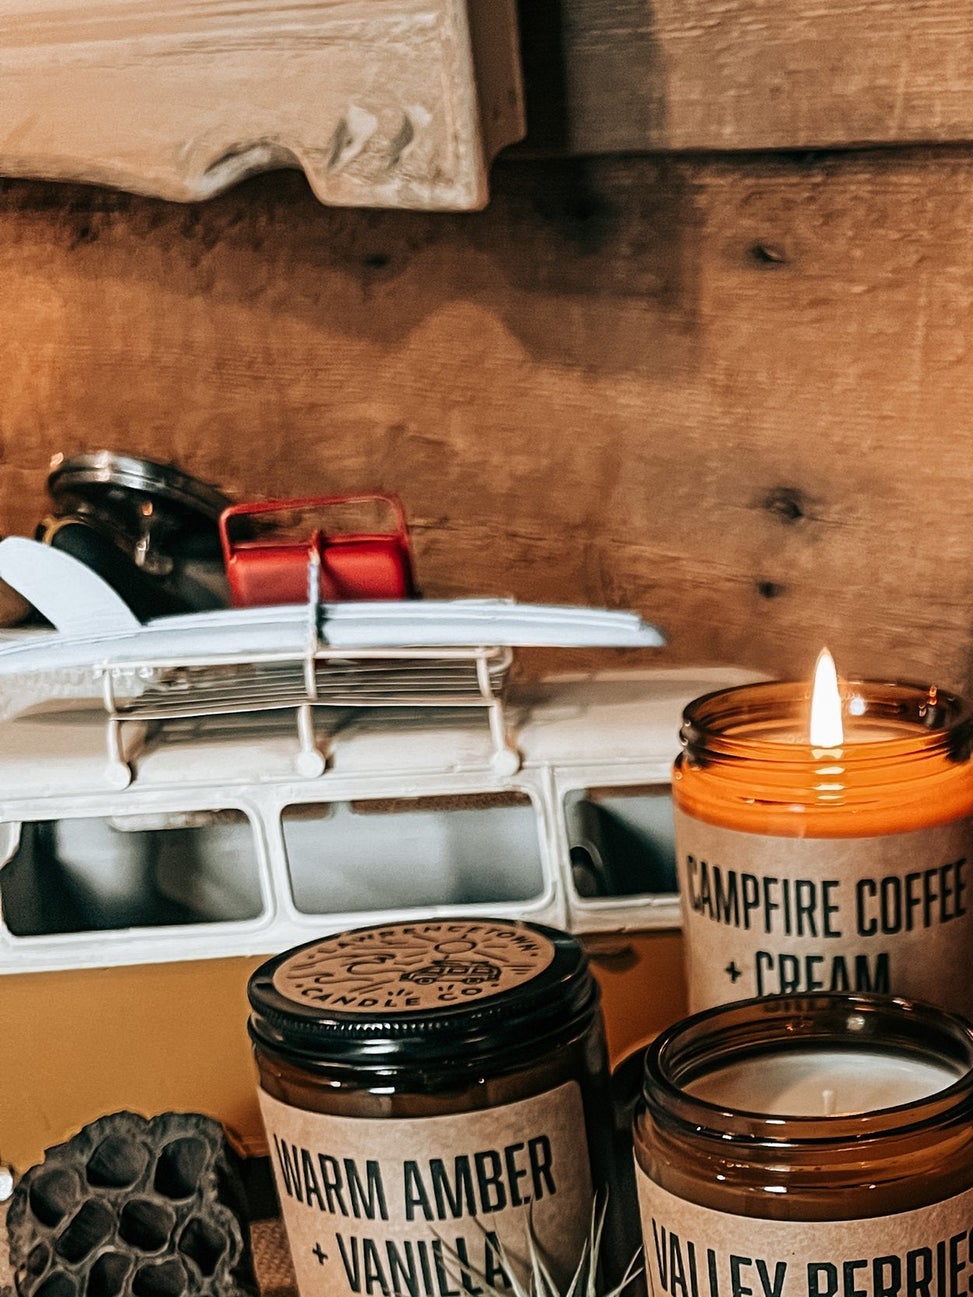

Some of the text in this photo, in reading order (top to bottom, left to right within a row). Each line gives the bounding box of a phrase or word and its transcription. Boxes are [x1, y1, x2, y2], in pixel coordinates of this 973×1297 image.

[686, 856, 966, 938] CAMPFIRE COFFEE
[318, 925, 540, 953] LAWRENCETOWN
[755, 950, 891, 997] CREAM
[301, 988, 421, 1007] CANDLE
[273, 1133, 557, 1222] WARM AMBER
